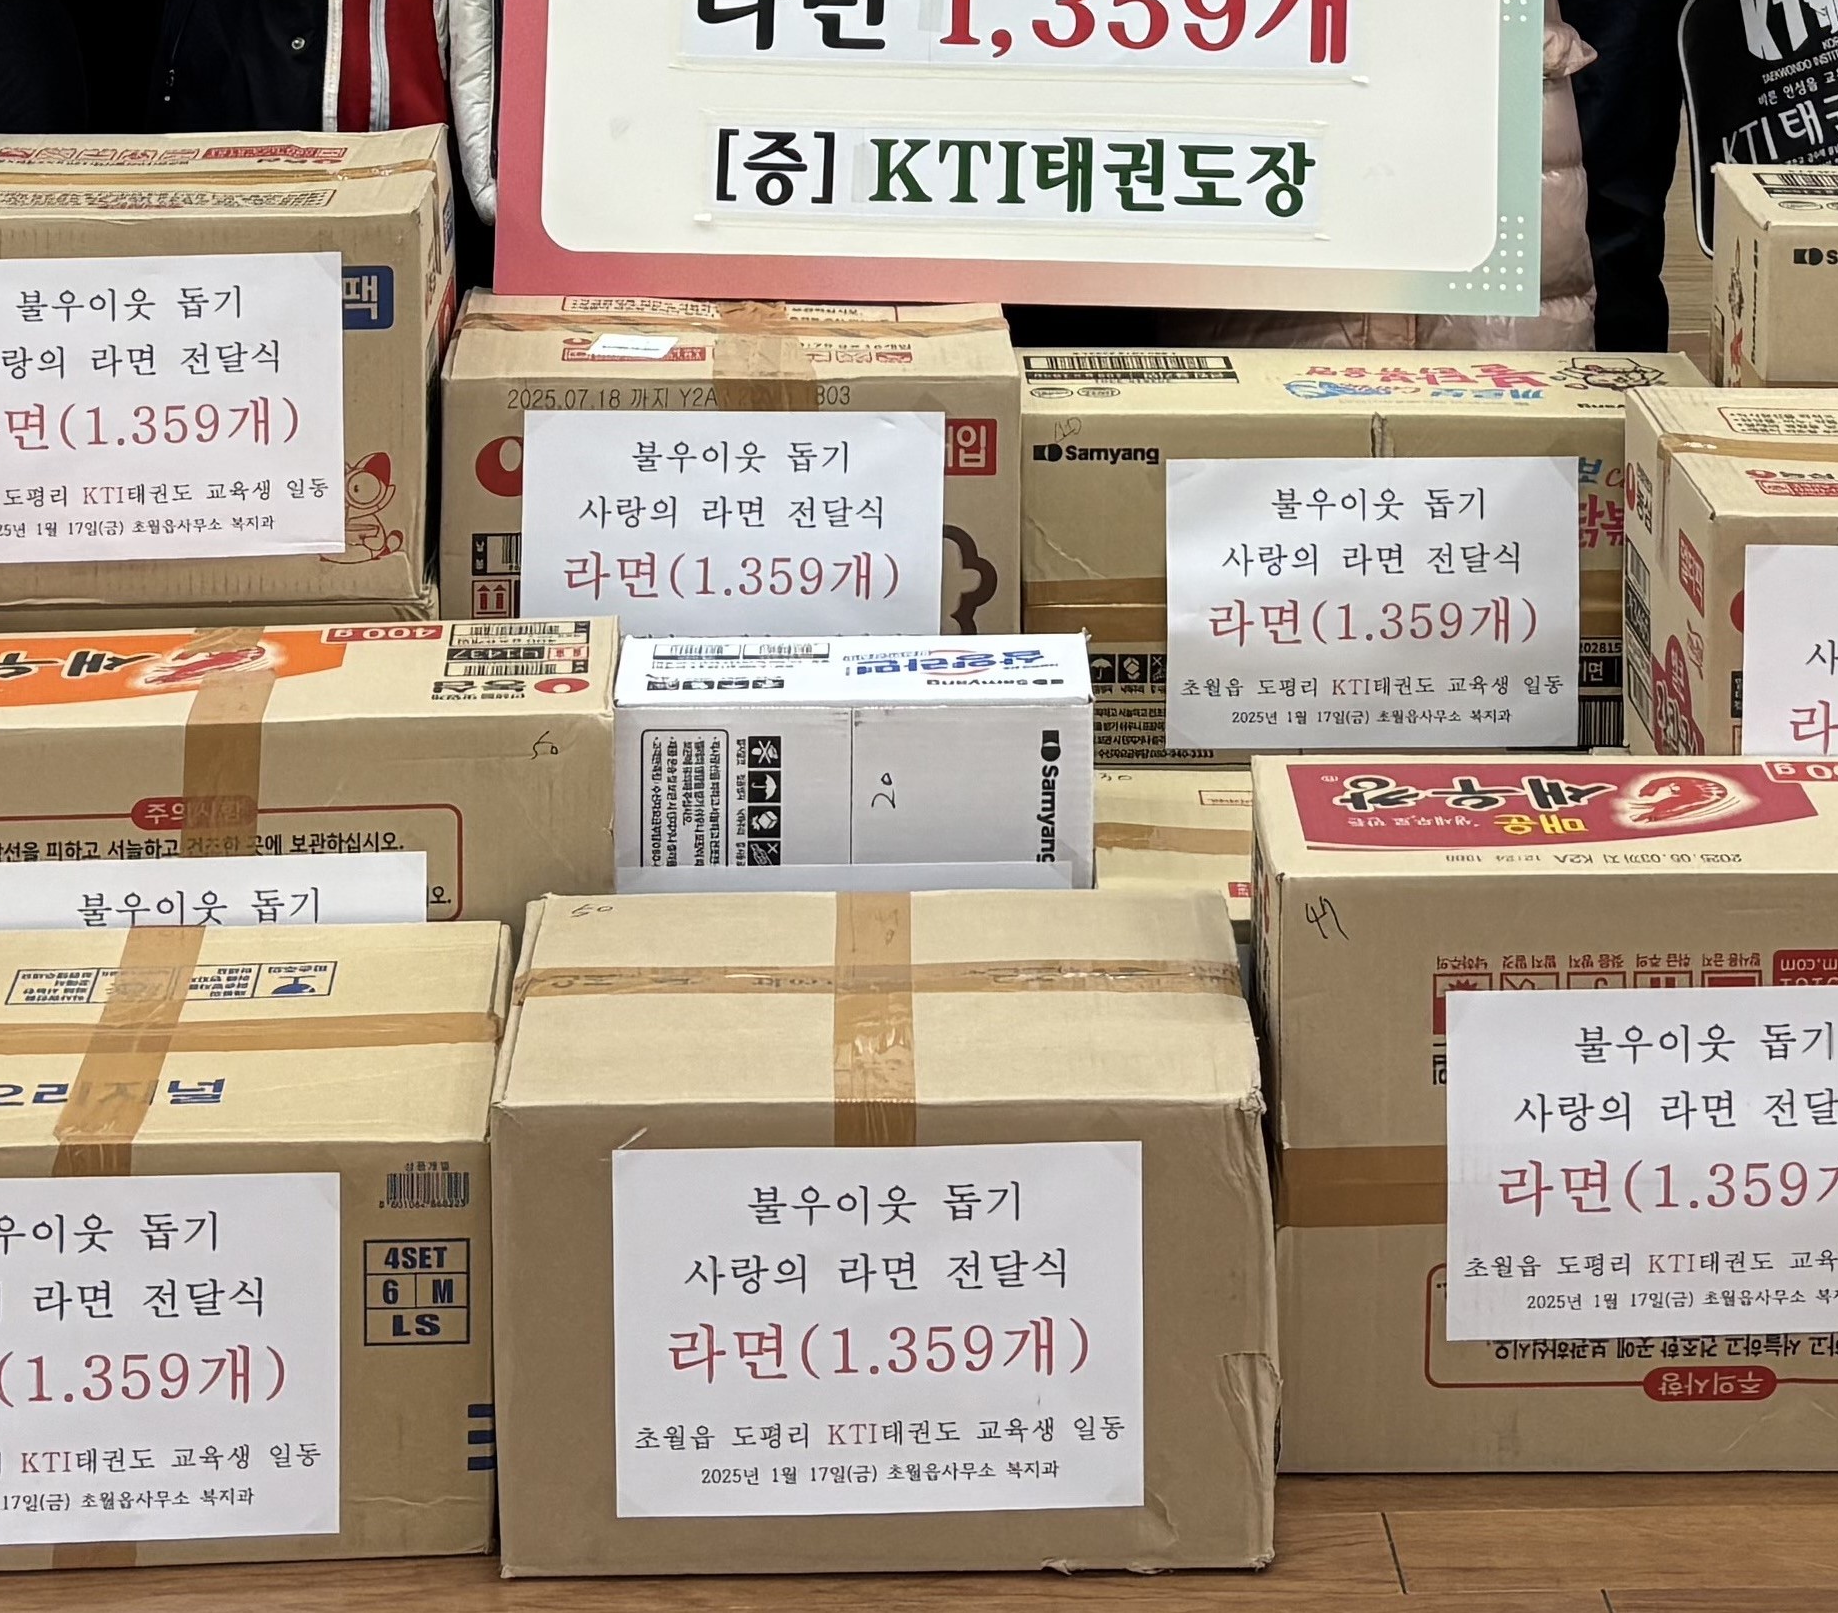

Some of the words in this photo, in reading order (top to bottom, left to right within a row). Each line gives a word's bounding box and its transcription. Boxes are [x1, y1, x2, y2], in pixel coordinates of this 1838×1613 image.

[1761, 58, 1813, 84] TAEKWONDO
[715, 130, 836, 205] [증]
[869, 137, 1316, 218] KTI태권도장
[508, 388, 622, 411] 2025.07.18
[630, 389, 668, 409] 까지
[1065, 444, 1160, 466] Samyang
[563, 550, 899, 601] 라면(1.359개)
[367, 626, 436, 638] 400
[1208, 596, 1537, 648] 라면(1.359개)
[1771, 761, 1798, 778] g
[1332, 775, 1617, 810] 새우깡
[1036, 764, 1061, 863] Samyang
[1494, 814, 1591, 836] 매운
[747, 1184, 917, 1227] 불우이웃
[942, 1180, 1020, 1222] 돕기
[139, 1210, 217, 1252] 돕기
[384, 1244, 448, 1270] 4SET
[684, 1253, 806, 1296] 사랑의
[838, 1251, 919, 1294] 라면
[946, 1247, 1066, 1290] 전달식
[382, 1278, 399, 1305] 6
[430, 1278, 455, 1305] M
[391, 1312, 442, 1338] LS
[668, 1316, 1089, 1385] 라면(1.359개)
[1657, 1371, 1765, 1396] 주의사항
[634, 1424, 716, 1451] 초월읍
[731, 1422, 809, 1449] 도평리
[827, 1419, 961, 1446] KTI태권도
[976, 1416, 1054, 1444] 교육생
[1073, 1415, 1125, 1441] 일동
[701, 1466, 760, 1486] 2025년
[772, 1465, 797, 1485] 1월
[810, 1464, 878, 1484] 17일(금)
[886, 1461, 997, 1482] 초월읍사무소
[1005, 1459, 1060, 1480] 복지과
